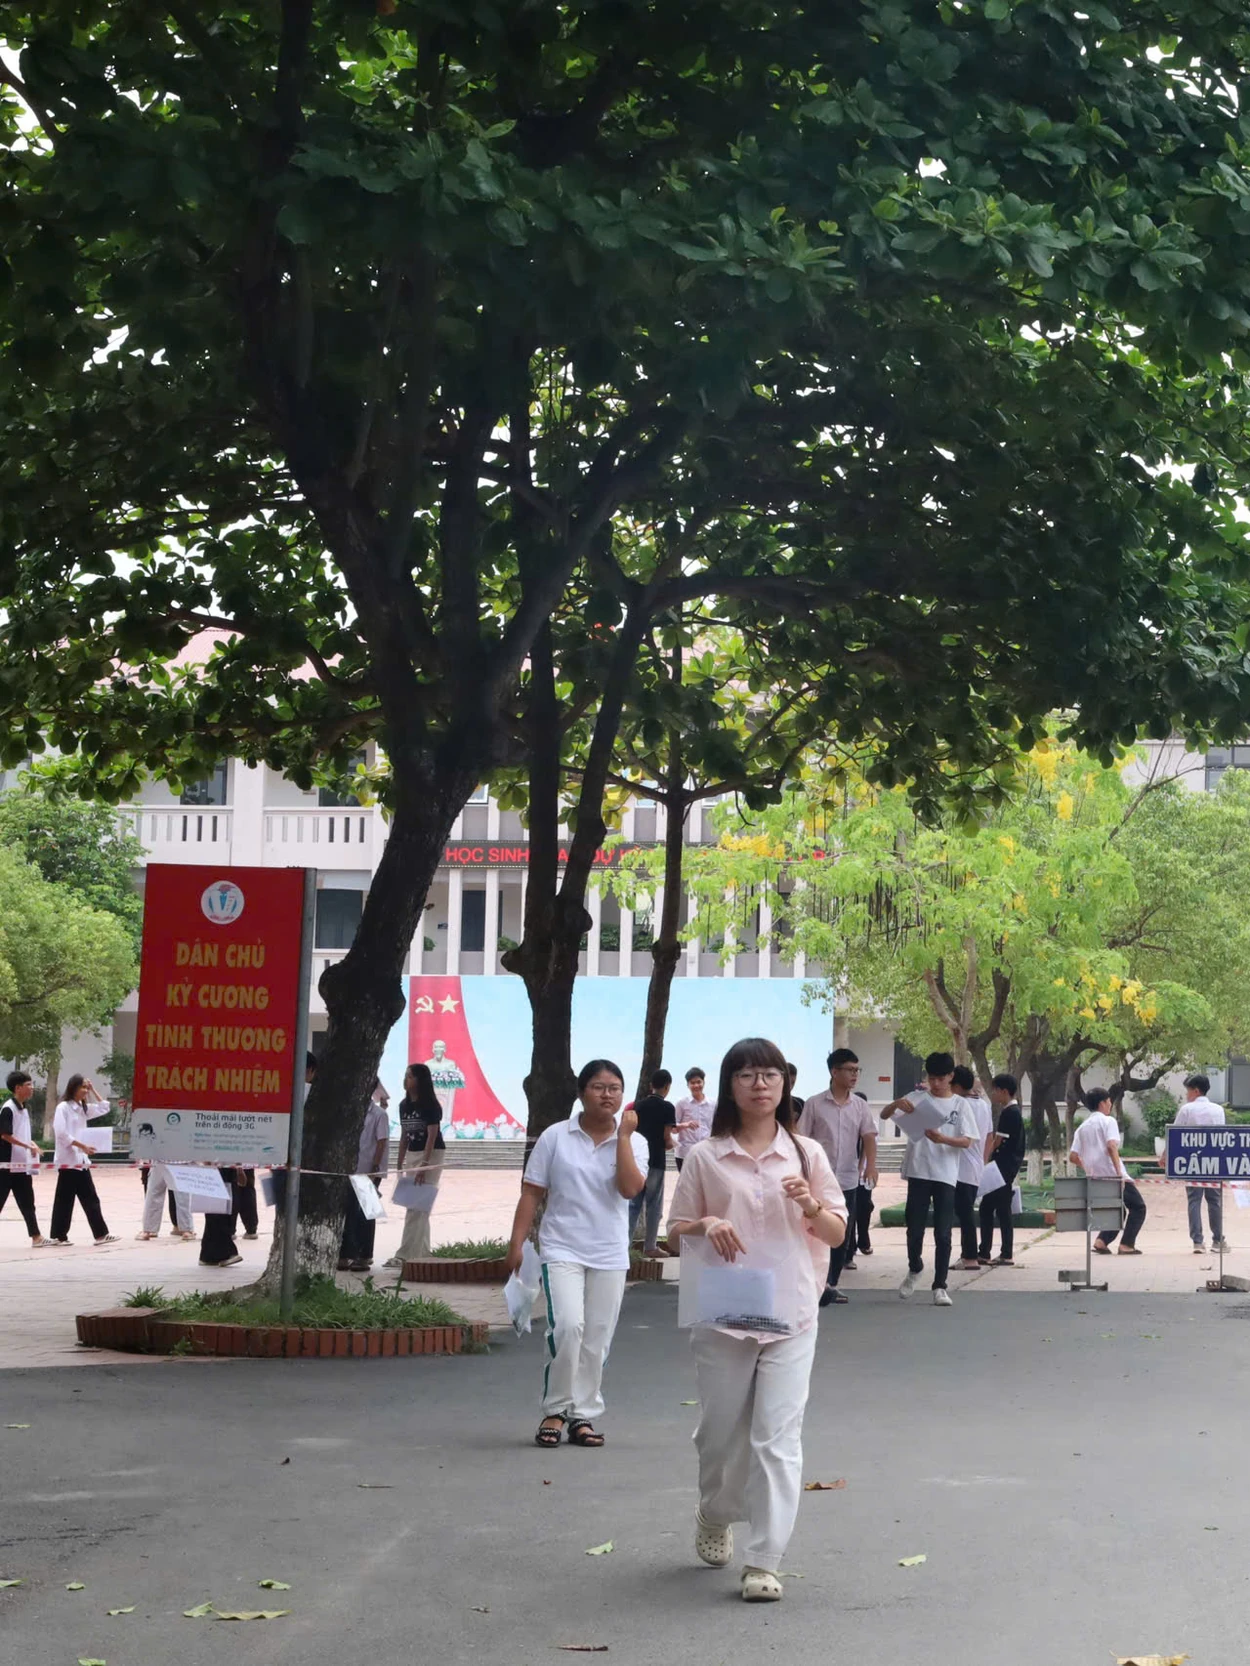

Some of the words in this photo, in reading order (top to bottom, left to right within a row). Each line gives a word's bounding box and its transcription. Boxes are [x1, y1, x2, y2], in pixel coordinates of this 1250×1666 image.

[445, 847, 483, 864] HỌC
[488, 847, 530, 863] SINH
[225, 937, 266, 969] CHỦ
[145, 1018, 193, 1049] TÌNH
[201, 1025, 287, 1053] THƯƠNG
[145, 1061, 208, 1092] TRÁCH
[214, 1063, 280, 1098] NHIỆM
[195, 1121, 212, 1129] trên
[213, 1121, 221, 1129] di
[222, 1122, 242, 1131] động
[1181, 1132, 1207, 1147] KHU
[1210, 1131, 1236, 1151] VỰC
[1173, 1150, 1220, 1175] CẤM
